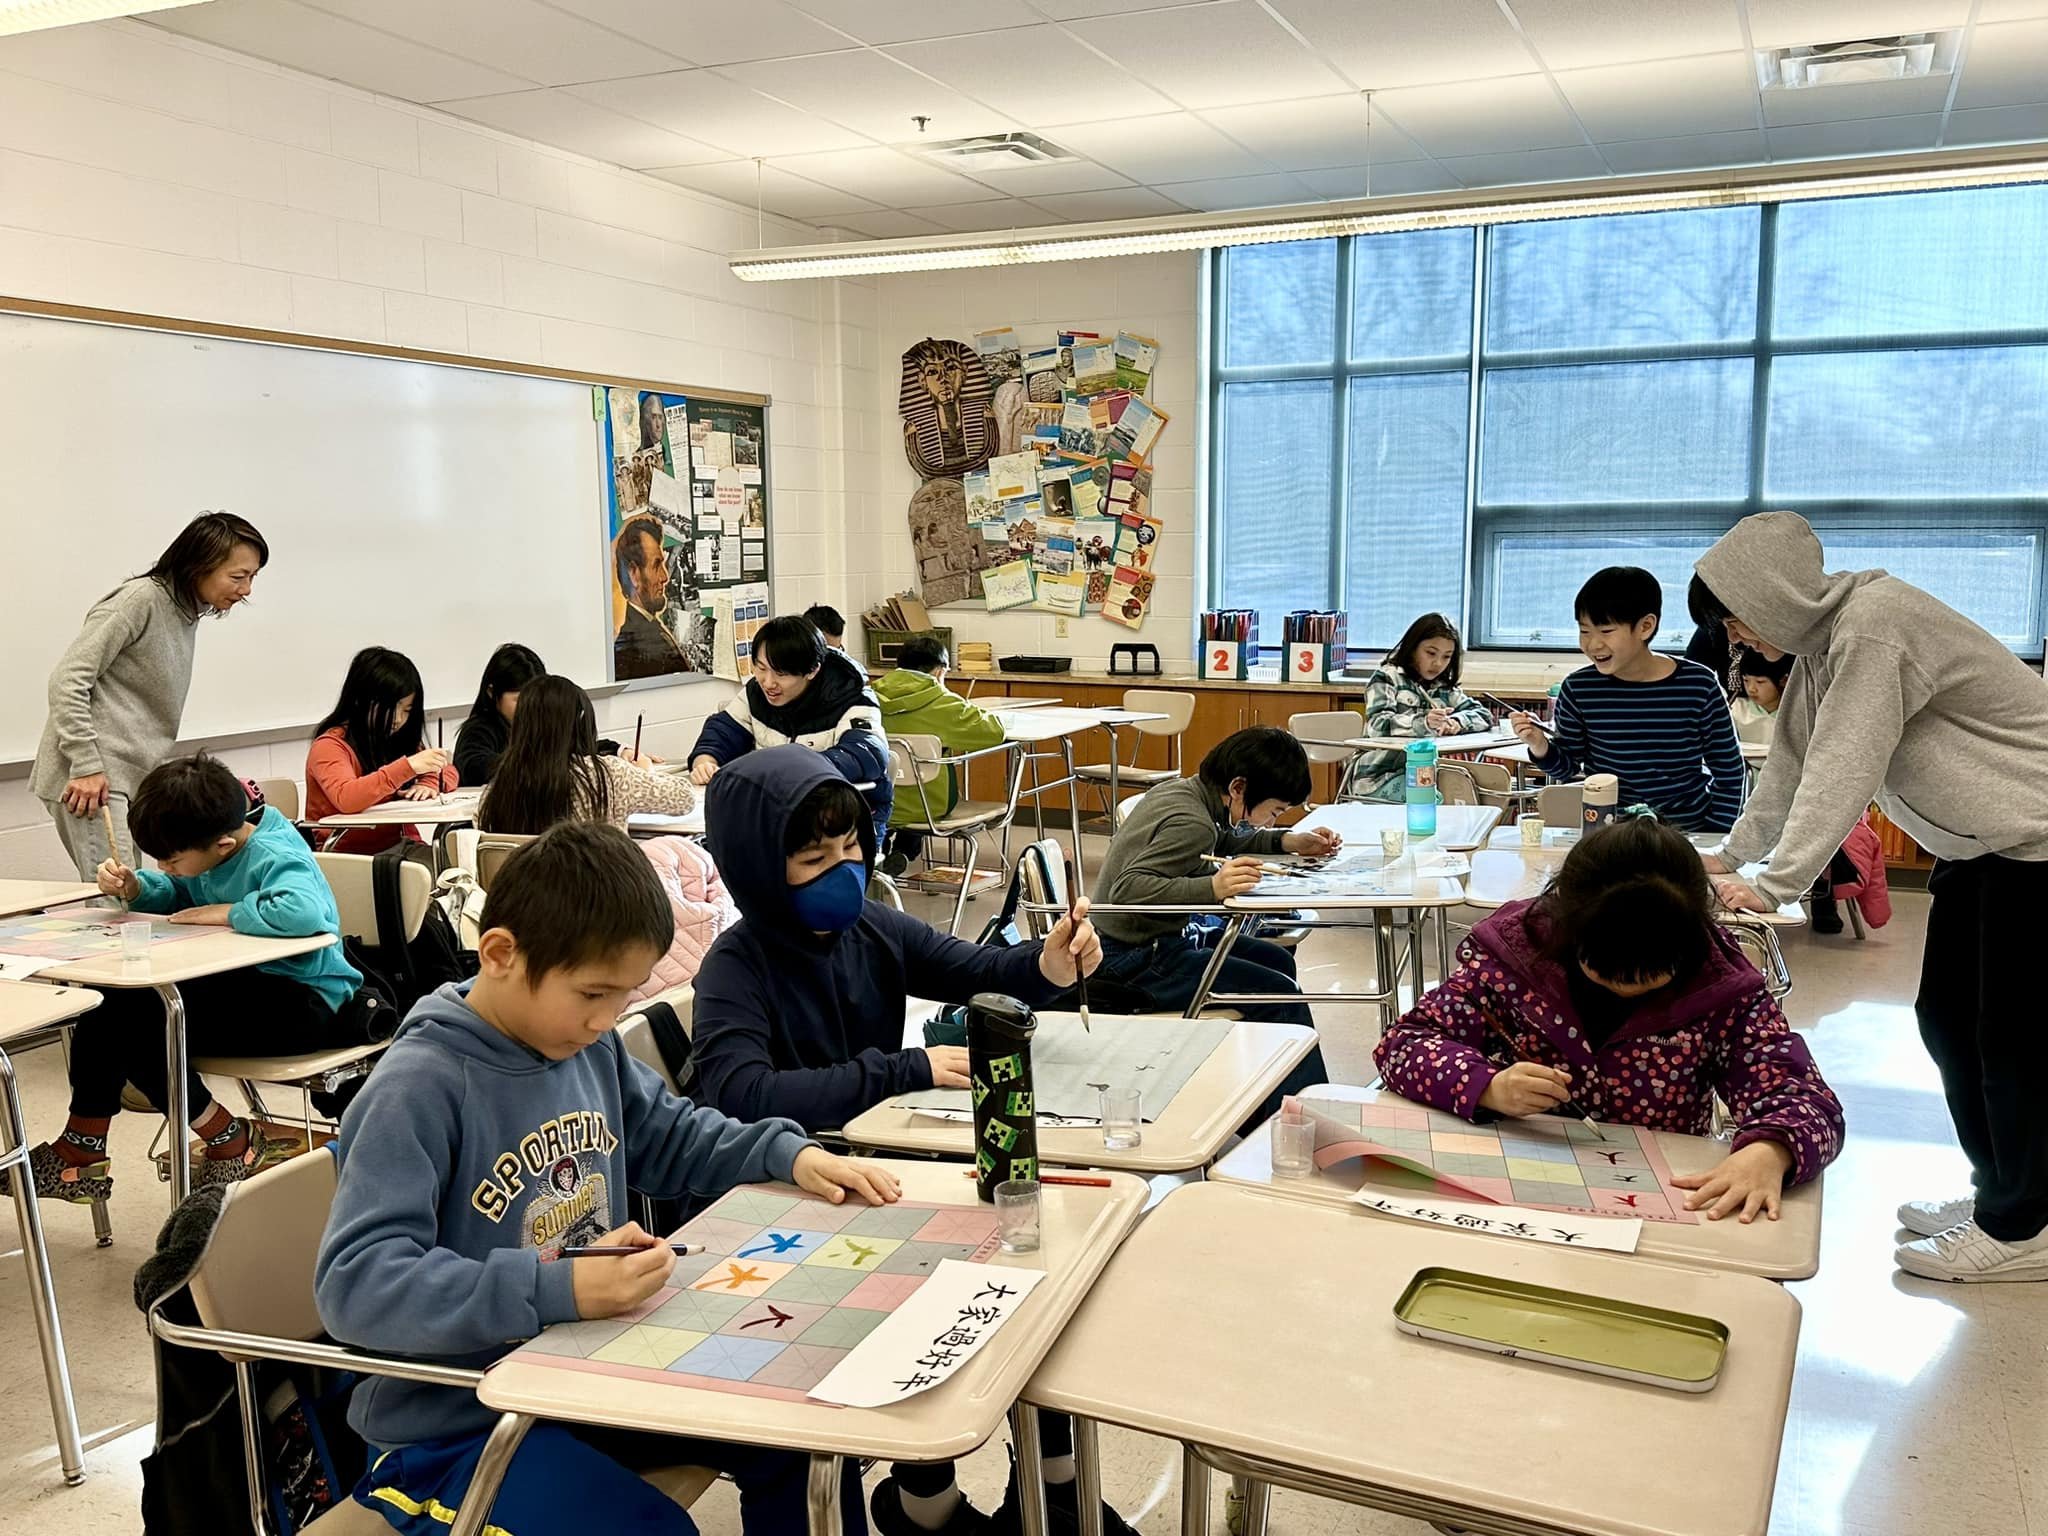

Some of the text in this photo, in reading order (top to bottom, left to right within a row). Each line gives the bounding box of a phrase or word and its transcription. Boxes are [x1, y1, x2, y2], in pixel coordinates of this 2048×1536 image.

[1213, 649, 1229, 671] 2
[1298, 651, 1314, 672] 3
[892, 1280, 1018, 1392] 大家過好年
